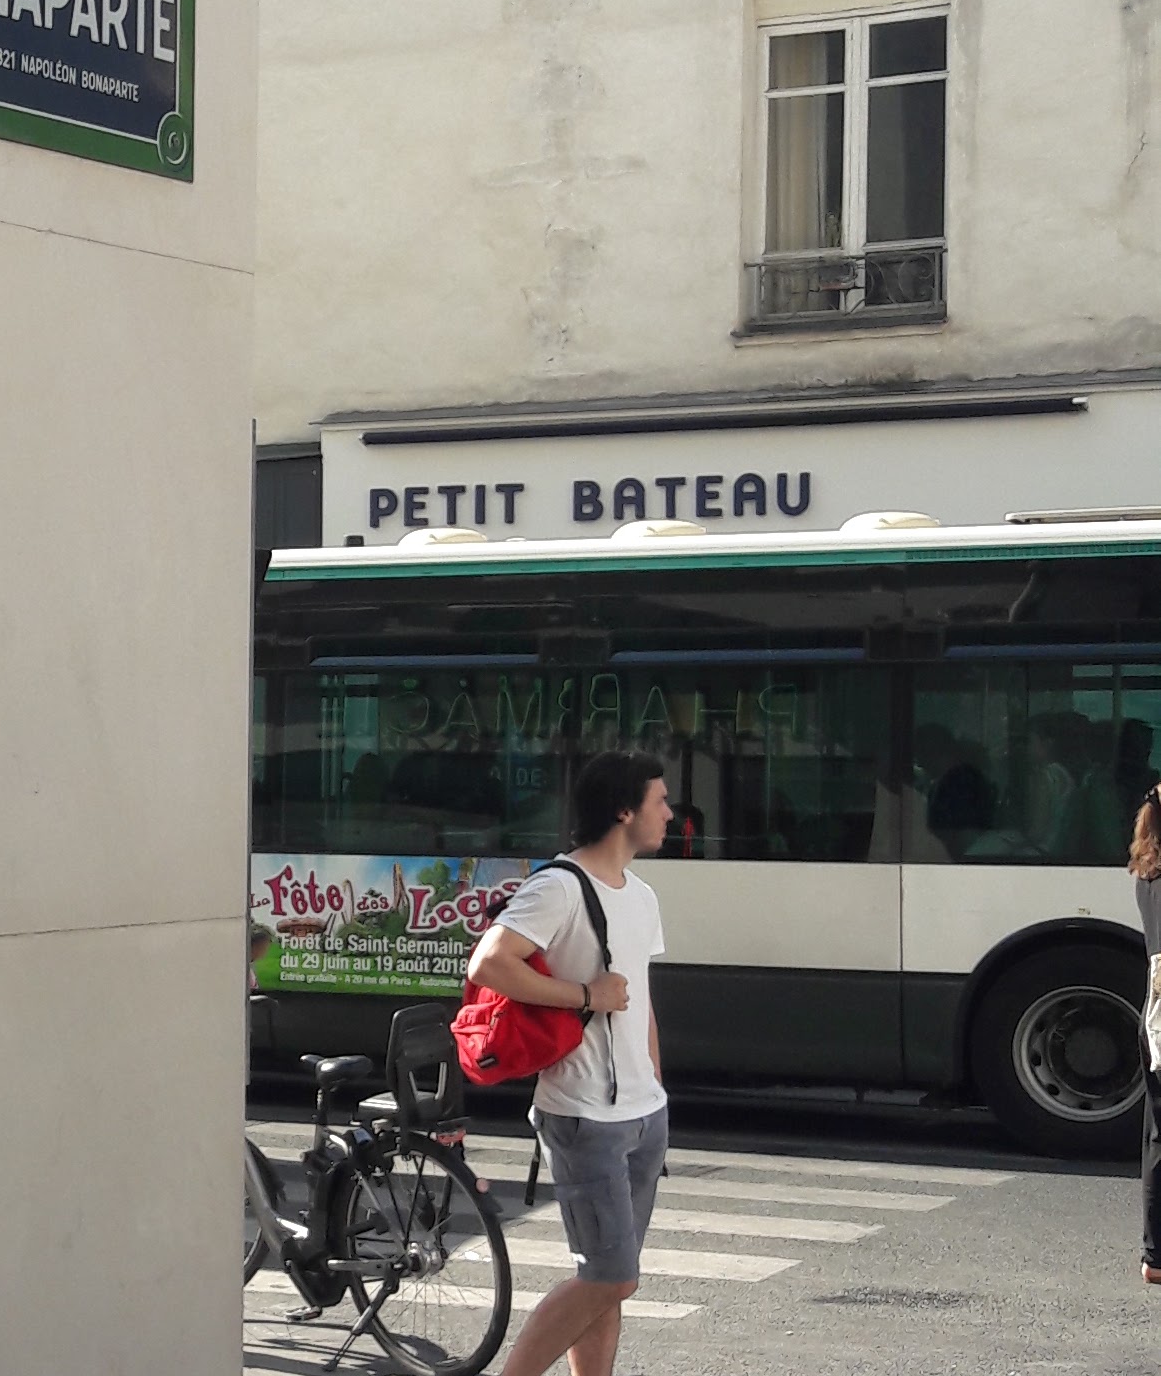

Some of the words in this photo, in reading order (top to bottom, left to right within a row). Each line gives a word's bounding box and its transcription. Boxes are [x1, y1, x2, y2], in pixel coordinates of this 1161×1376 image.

[21, 52, 76, 86] NAPOLÉON
[81, 70, 139, 103] BONAPARTE
[369, 483, 525, 528] PETIT
[573, 472, 811, 521] BATEAU
[264, 864, 344, 916] Fête
[280, 933, 321, 950] Forêt
[325, 936, 345, 951] de
[347, 934, 477, 956] Saint-Germain-
[280, 953, 298, 968] du
[301, 952, 320, 968] 29
[322, 953, 349, 972] juin
[352, 958, 372, 971] au
[374, 955, 393, 972] 19
[395, 956, 430, 973] août
[431, 957, 468, 974] 2018
